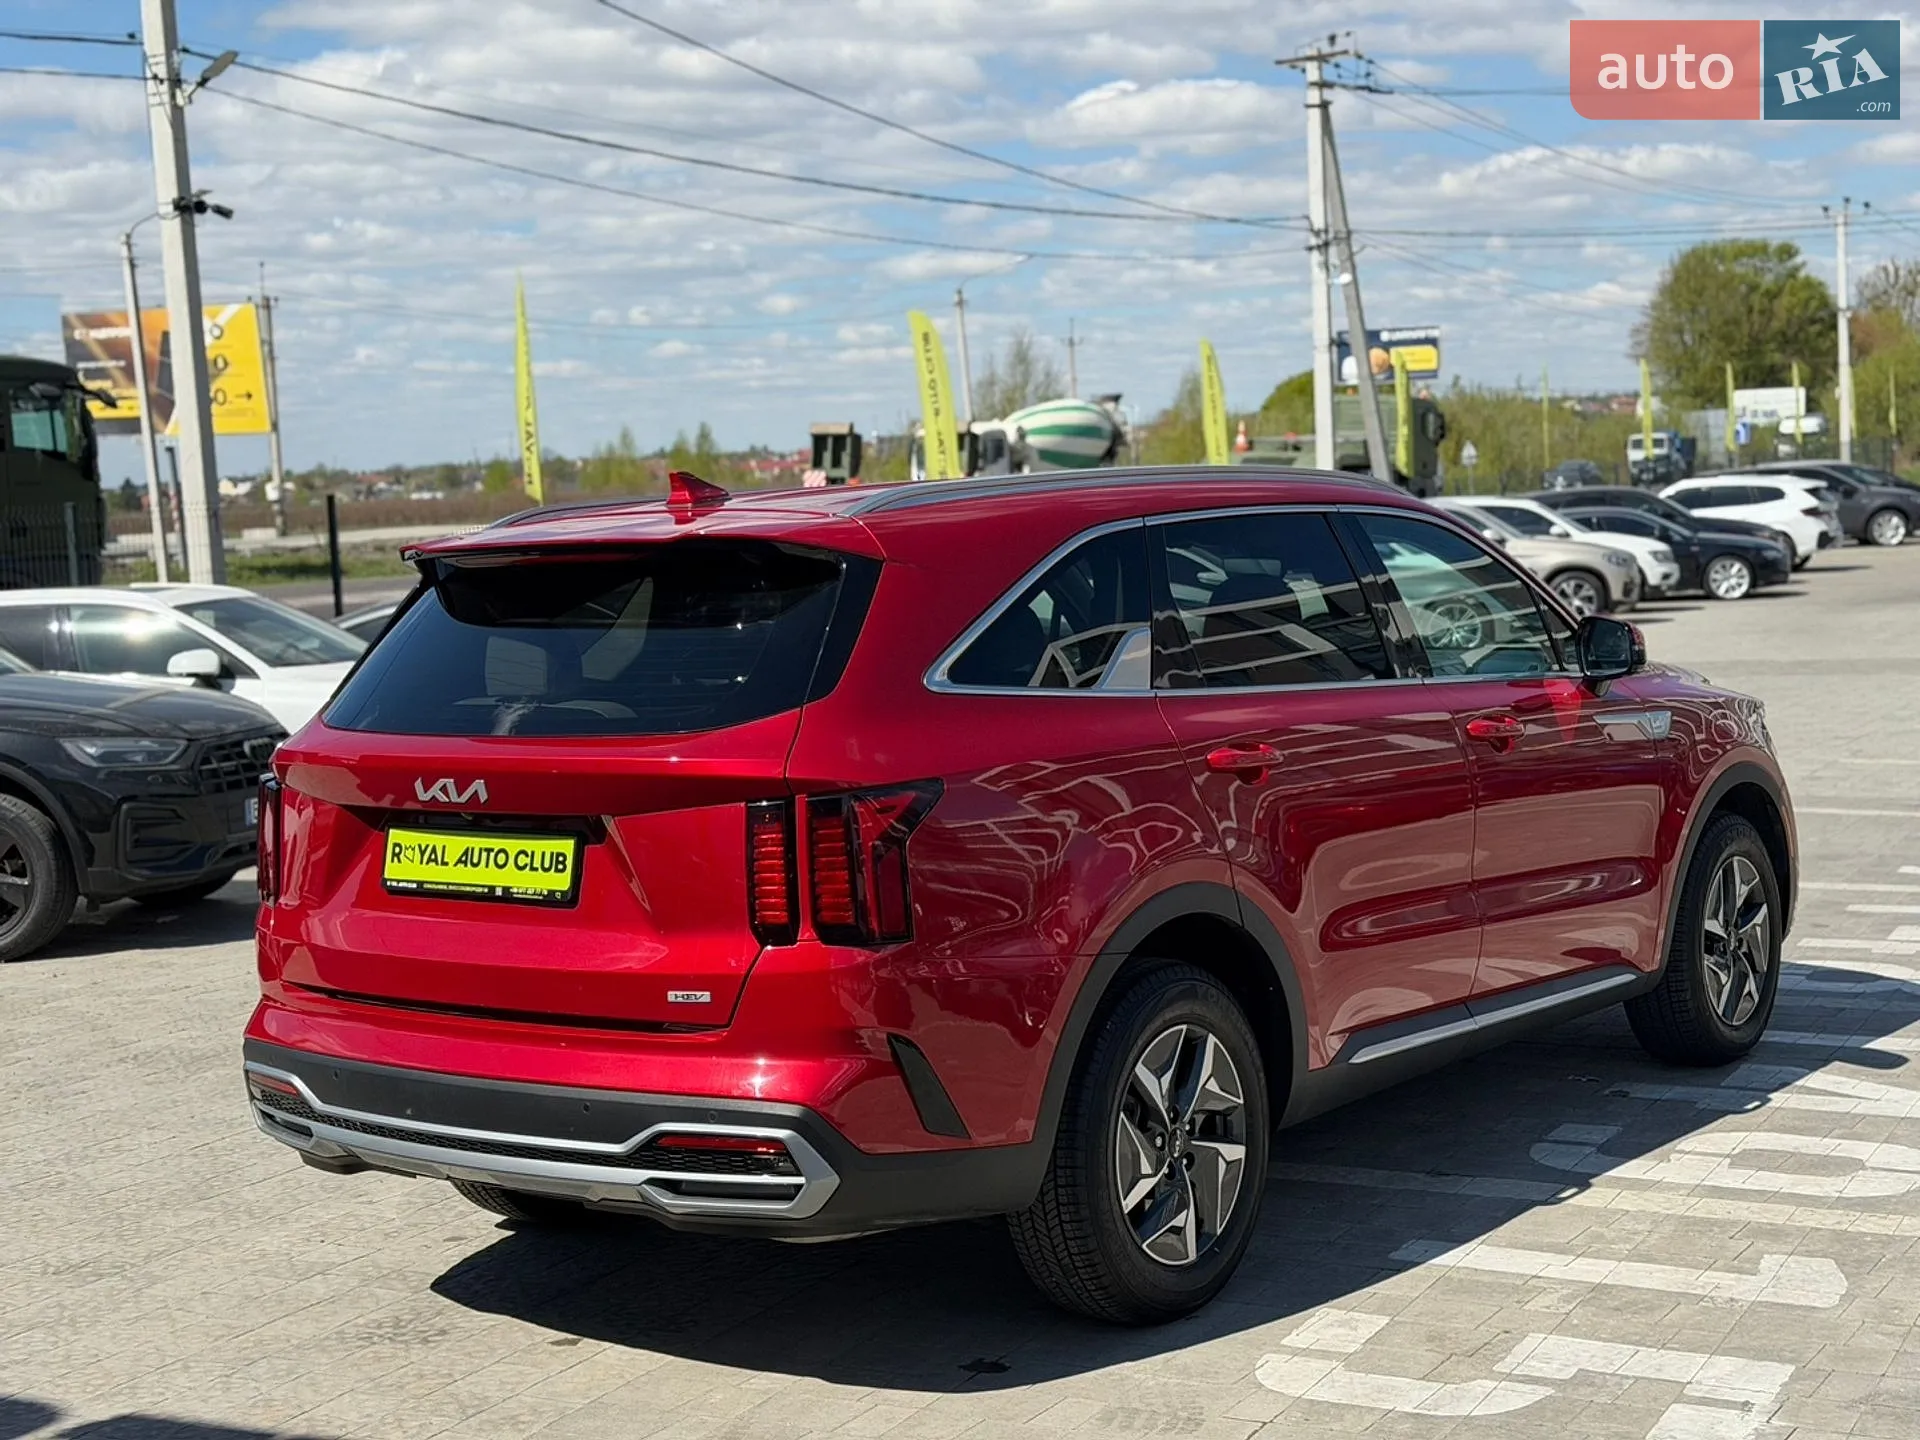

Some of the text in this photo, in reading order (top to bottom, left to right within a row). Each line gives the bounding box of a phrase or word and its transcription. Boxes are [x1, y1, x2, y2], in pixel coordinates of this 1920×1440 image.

[414, 777, 488, 803] KIA
[453, 846, 509, 870] AUTO
[513, 850, 568, 874] CLUB
